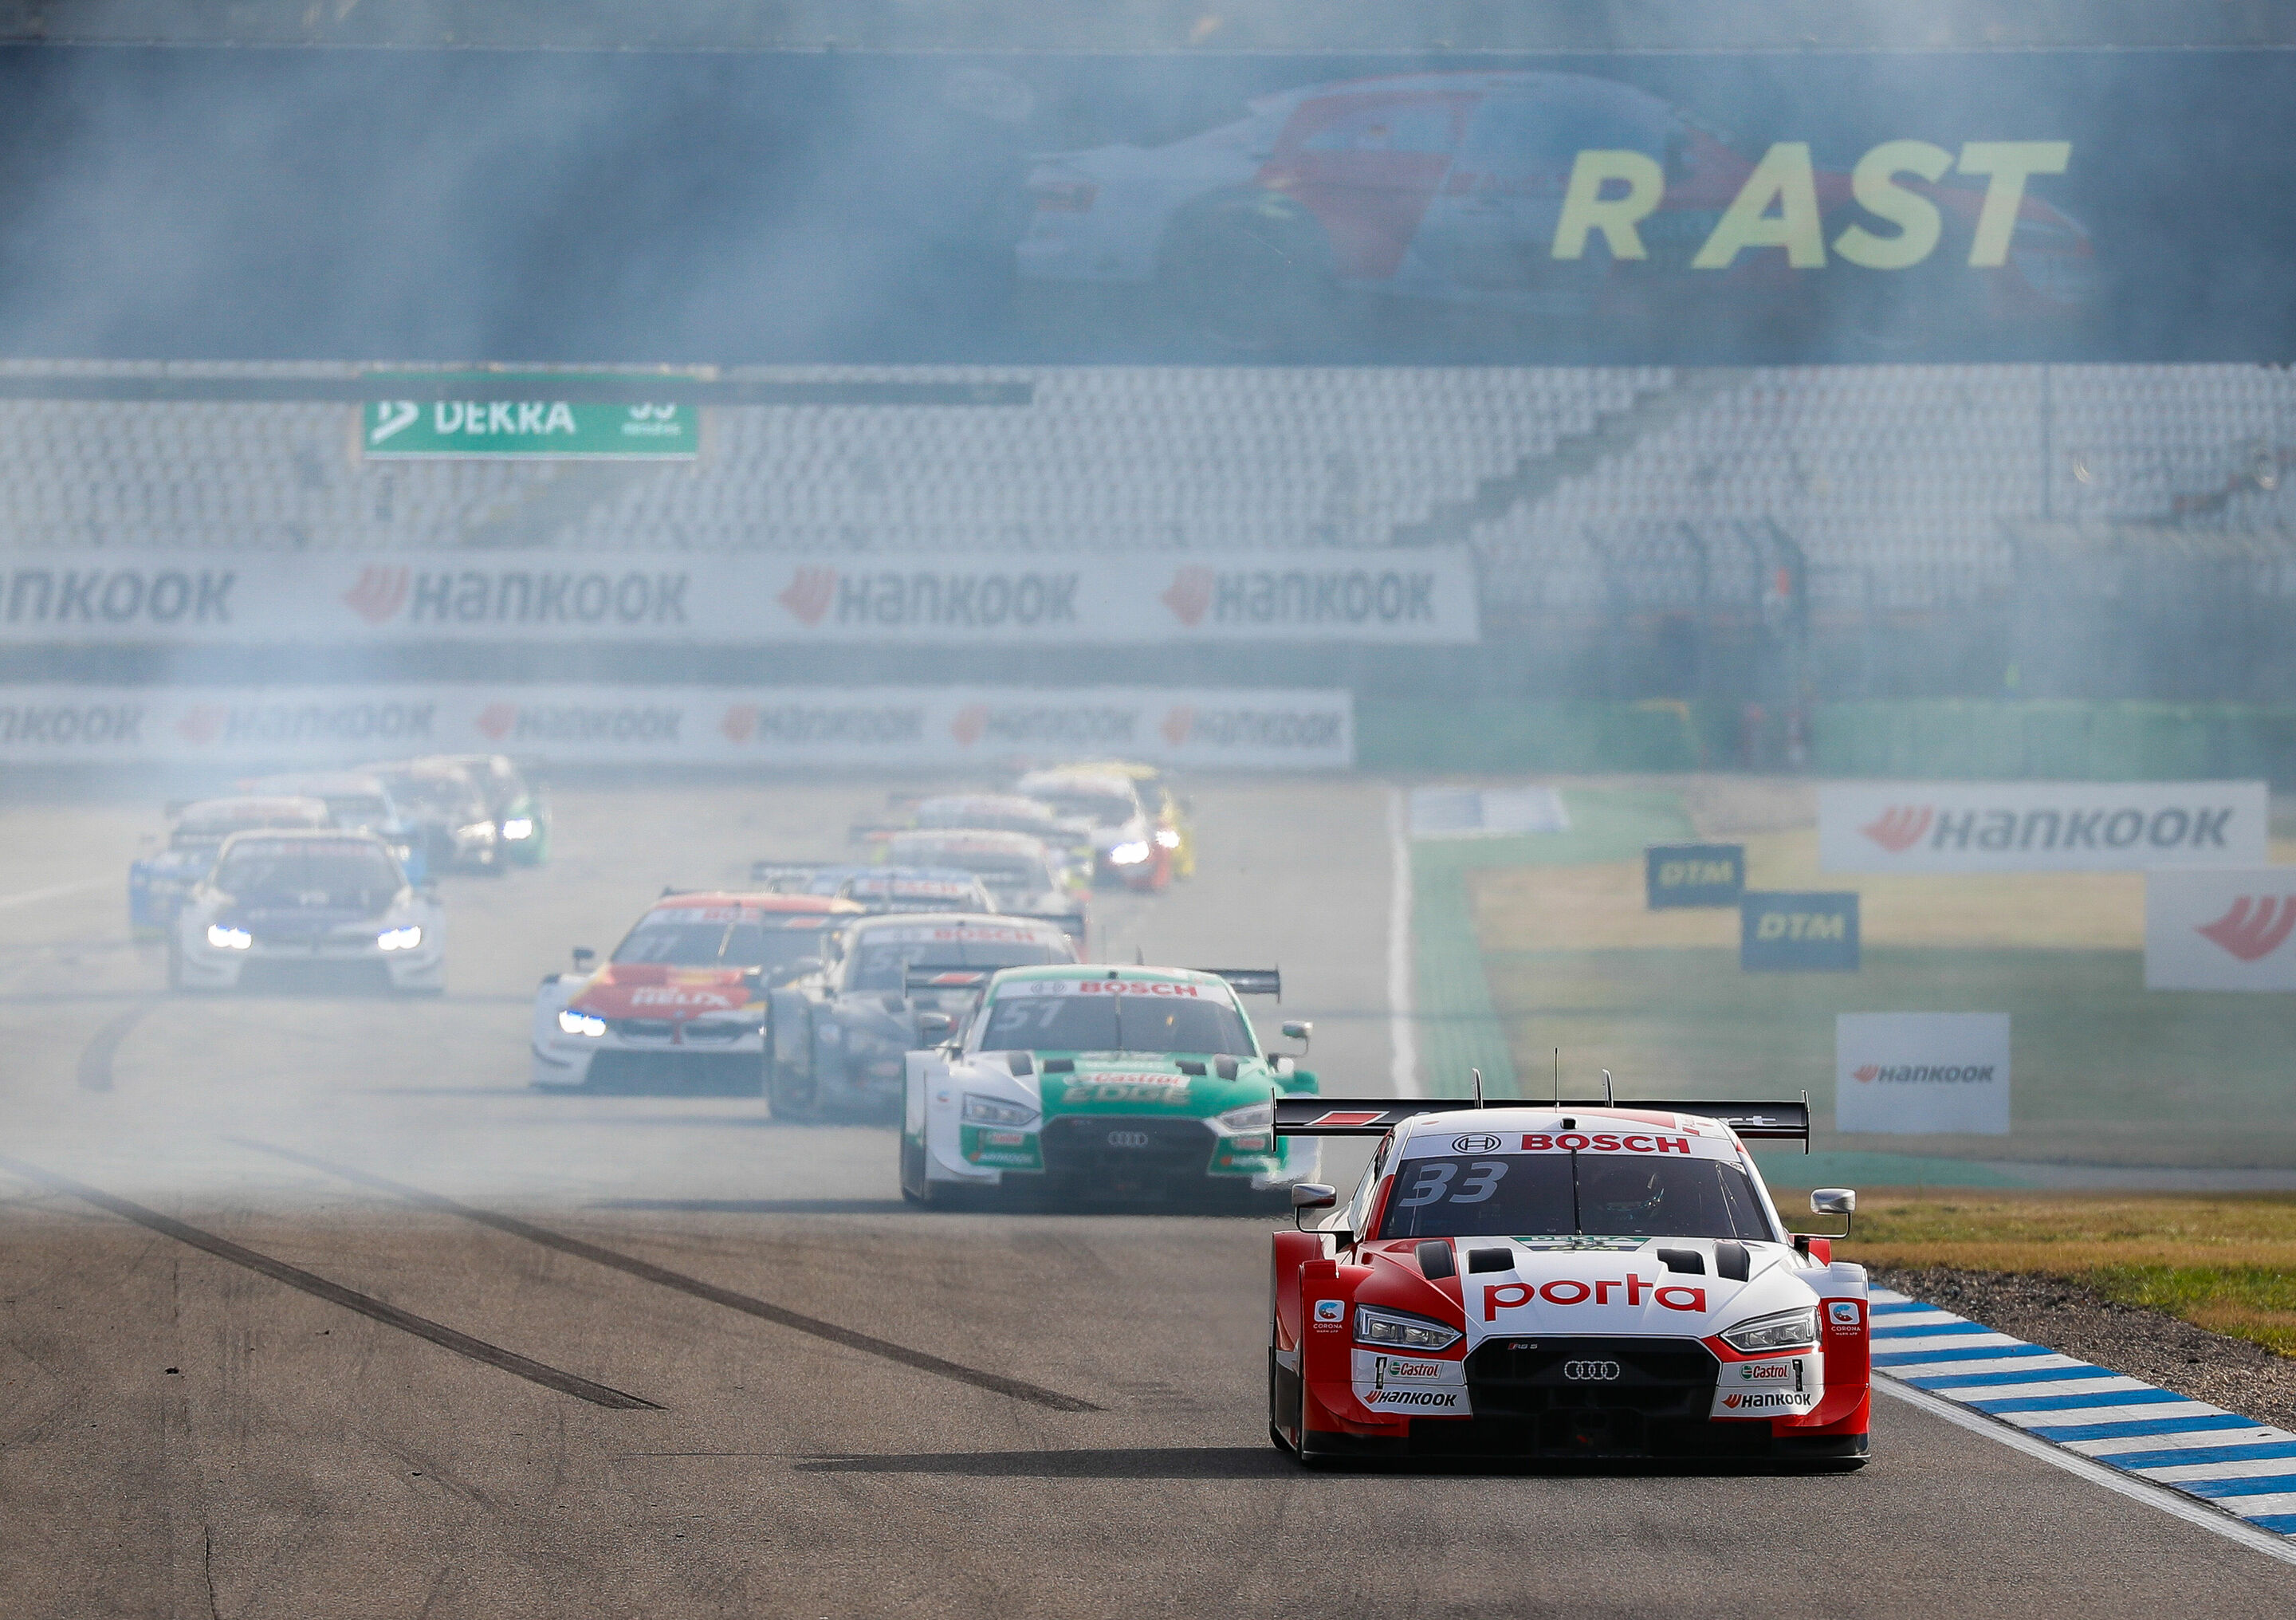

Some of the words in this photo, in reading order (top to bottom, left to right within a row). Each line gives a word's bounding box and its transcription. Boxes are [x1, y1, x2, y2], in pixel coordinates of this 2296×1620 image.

[434, 401, 576, 435] DEKRA
[0, 568, 238, 625] nkook
[1932, 806, 2233, 851] Hankook
[1658, 860, 1734, 887] DTM
[1757, 910, 1844, 942] DTM
[1079, 981, 1198, 997] BOSCH
[997, 999, 1066, 1032] 51
[1092, 1072, 1181, 1085] Castrol
[1877, 1064, 1995, 1083] Hankook
[1063, 1084, 1191, 1105] EDGE
[1520, 1134, 1692, 1154] BOSCH
[1398, 1161, 1509, 1207] 33
[1484, 1273, 1708, 1323] porta
[1401, 1362, 1440, 1377] Castrol
[1753, 1365, 1788, 1378] Castrol
[1378, 1390, 1457, 1407] Hankook
[1741, 1394, 1811, 1408] Hankook
